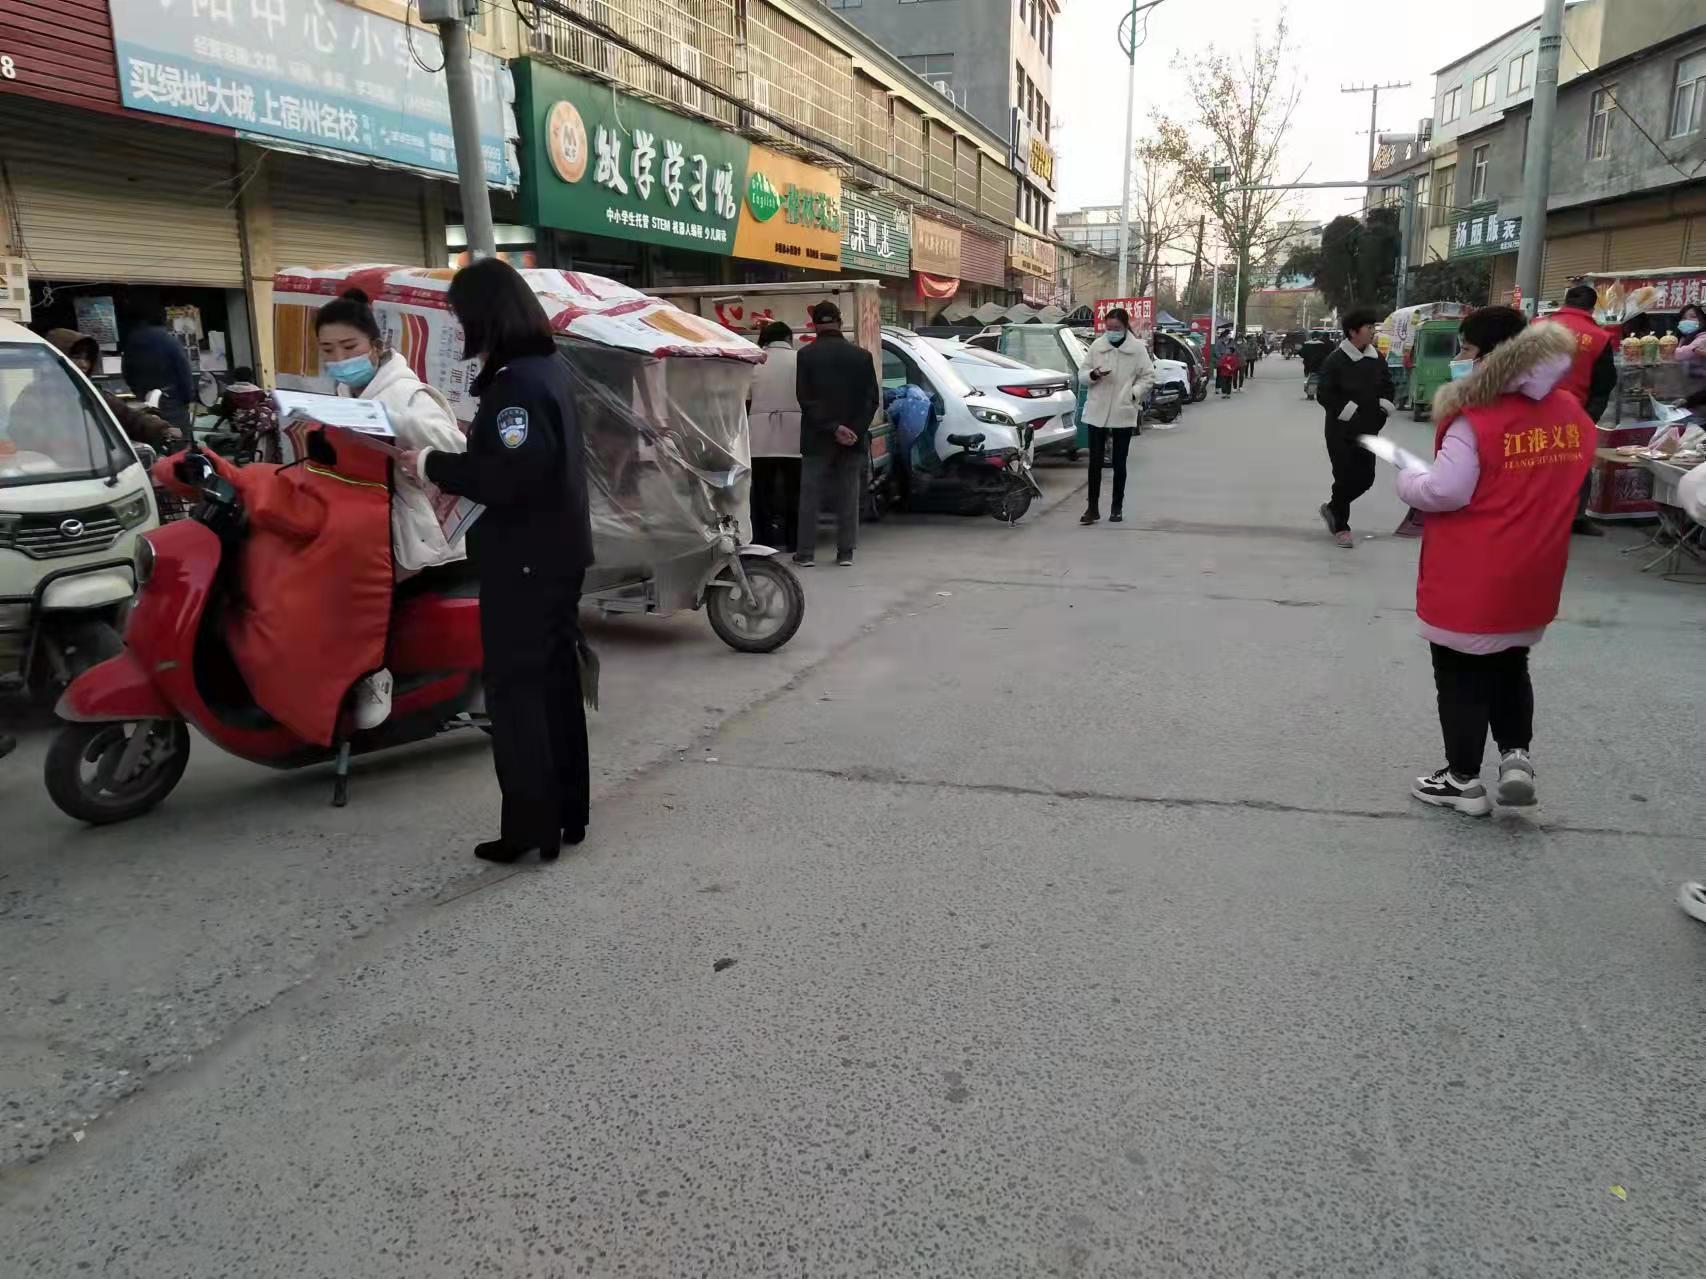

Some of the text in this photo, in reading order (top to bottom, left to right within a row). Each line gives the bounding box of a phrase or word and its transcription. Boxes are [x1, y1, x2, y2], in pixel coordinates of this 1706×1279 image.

[0, 55, 16, 79] 8
[128, 57, 257, 123] 买绿地大城
[260, 89, 359, 144] 上宿州名校
[606, 206, 649, 229] 中小学生托管
[652, 216, 671, 232] STEM
[672, 220, 703, 239] 机器人编程
[1504, 424, 1580, 457] 江淮义警
